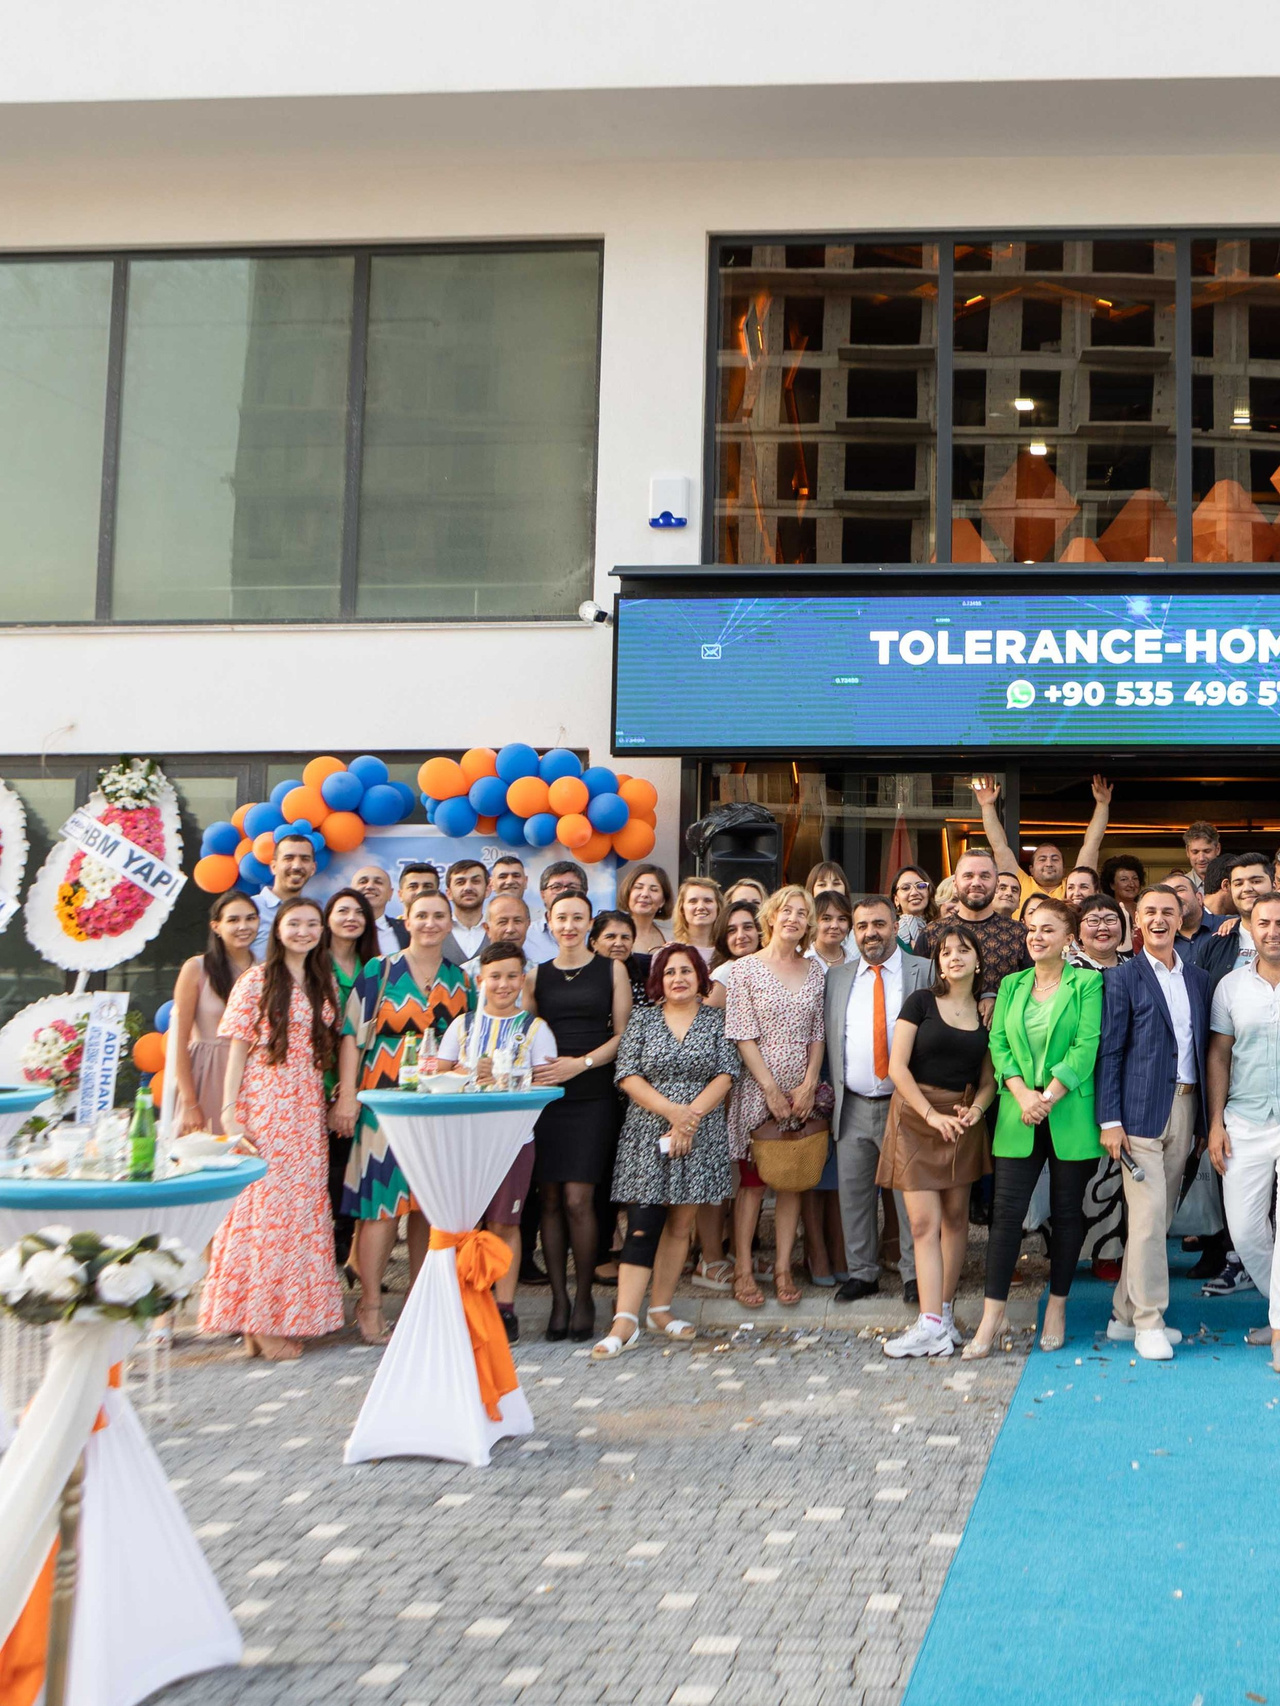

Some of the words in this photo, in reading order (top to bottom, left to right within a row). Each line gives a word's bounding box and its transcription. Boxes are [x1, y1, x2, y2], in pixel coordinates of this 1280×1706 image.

[1044, 681, 1105, 706] +90
[1114, 681, 1175, 706] 535
[1183, 681, 1248, 706] 496
[122, 848, 180, 897] YAPI
[96, 1031, 118, 1111] ADLIHAN
